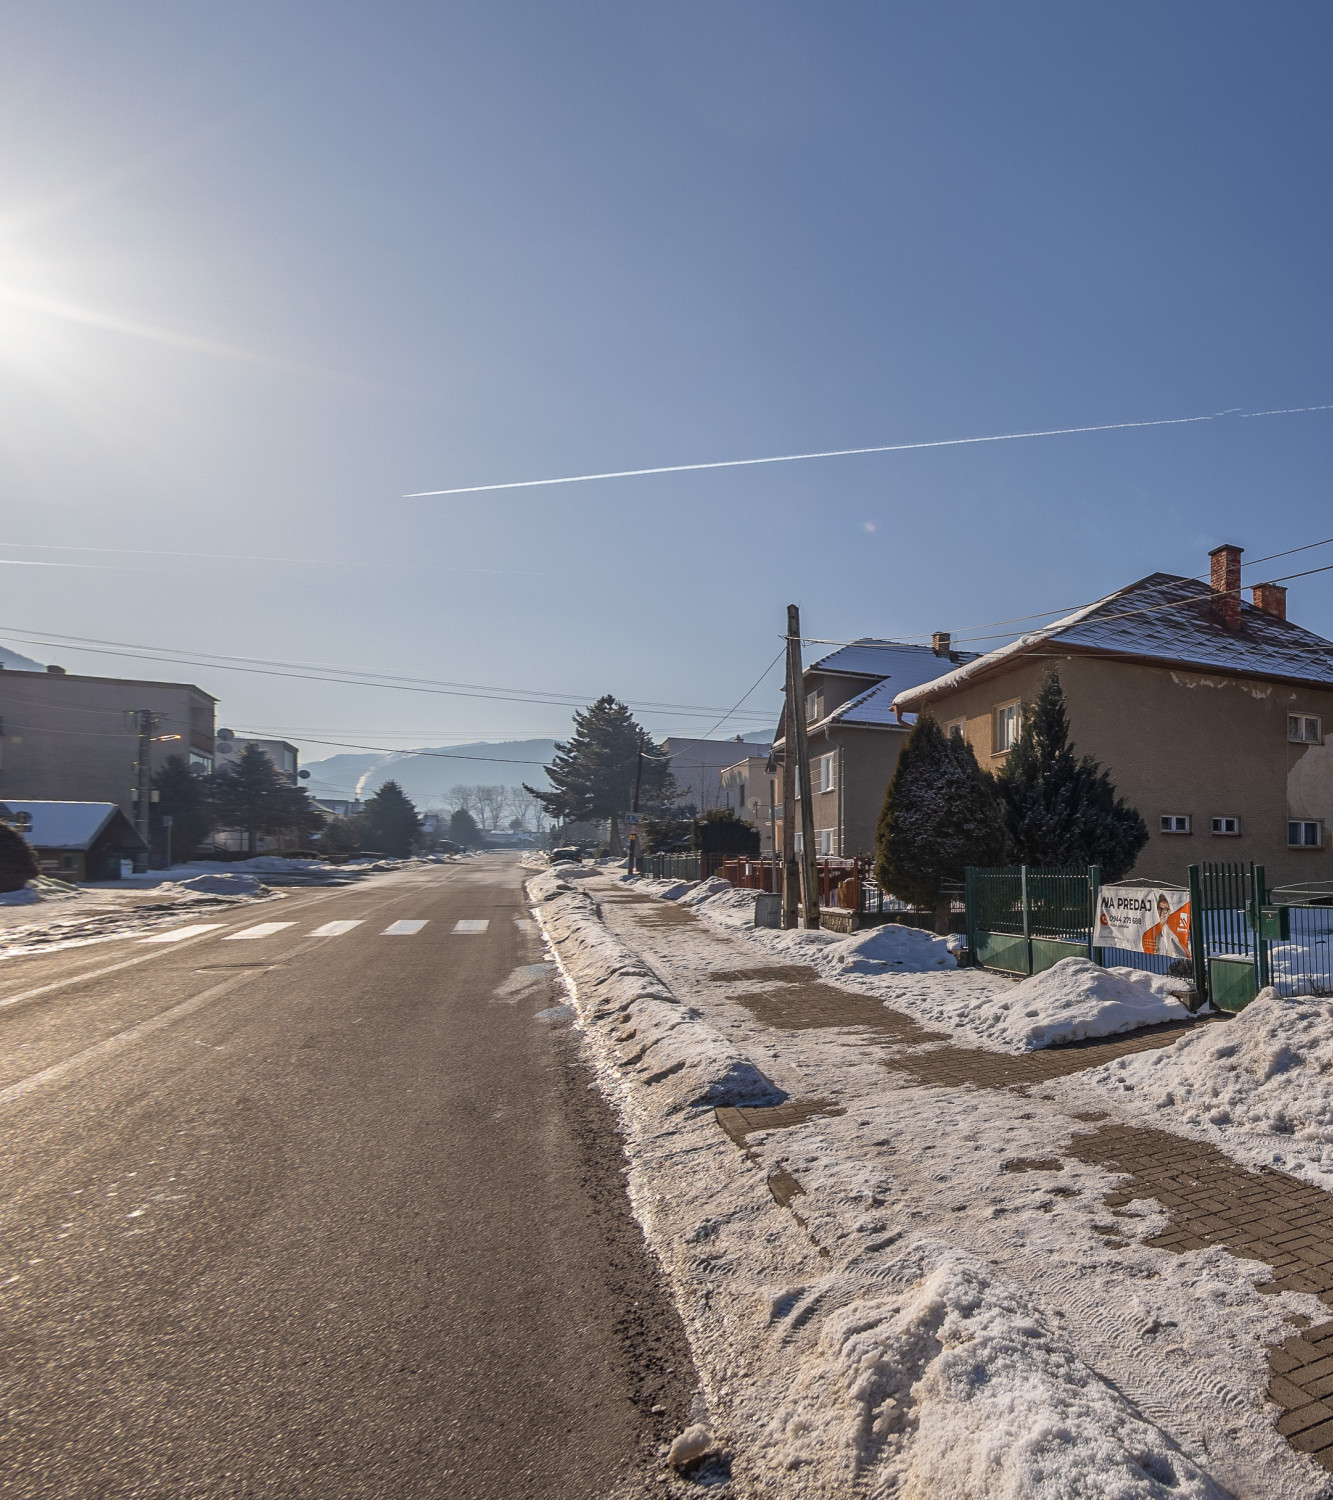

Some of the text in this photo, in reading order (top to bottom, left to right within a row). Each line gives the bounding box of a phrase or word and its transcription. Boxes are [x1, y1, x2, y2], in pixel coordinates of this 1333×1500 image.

[1101, 896, 1152, 912] NA PREDAJ
[1109, 915, 1122, 923] 0944
